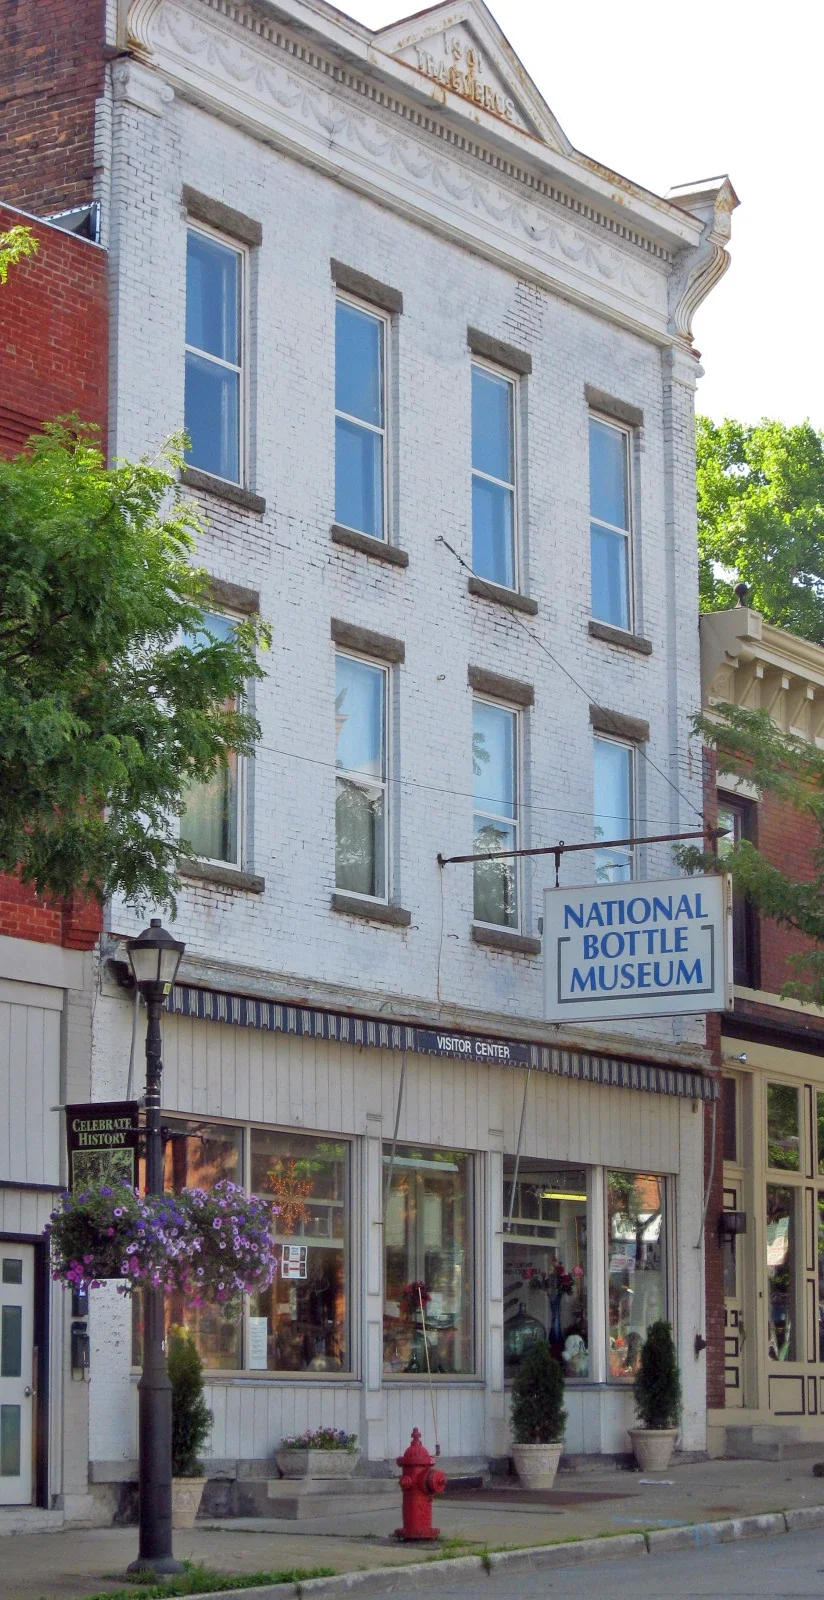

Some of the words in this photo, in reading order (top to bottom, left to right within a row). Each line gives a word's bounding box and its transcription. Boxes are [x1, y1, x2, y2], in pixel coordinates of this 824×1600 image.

[564, 893, 708, 929] NATIONAL
[583, 927, 688, 960] BOTTLE
[570, 958, 703, 992] MUSEUM
[437, 1036, 472, 1053] VISITOR
[475, 1041, 510, 1059] CENTER
[72, 1118, 132, 1132] CELEBRATE
[79, 1133, 127, 1146] HISTORY
